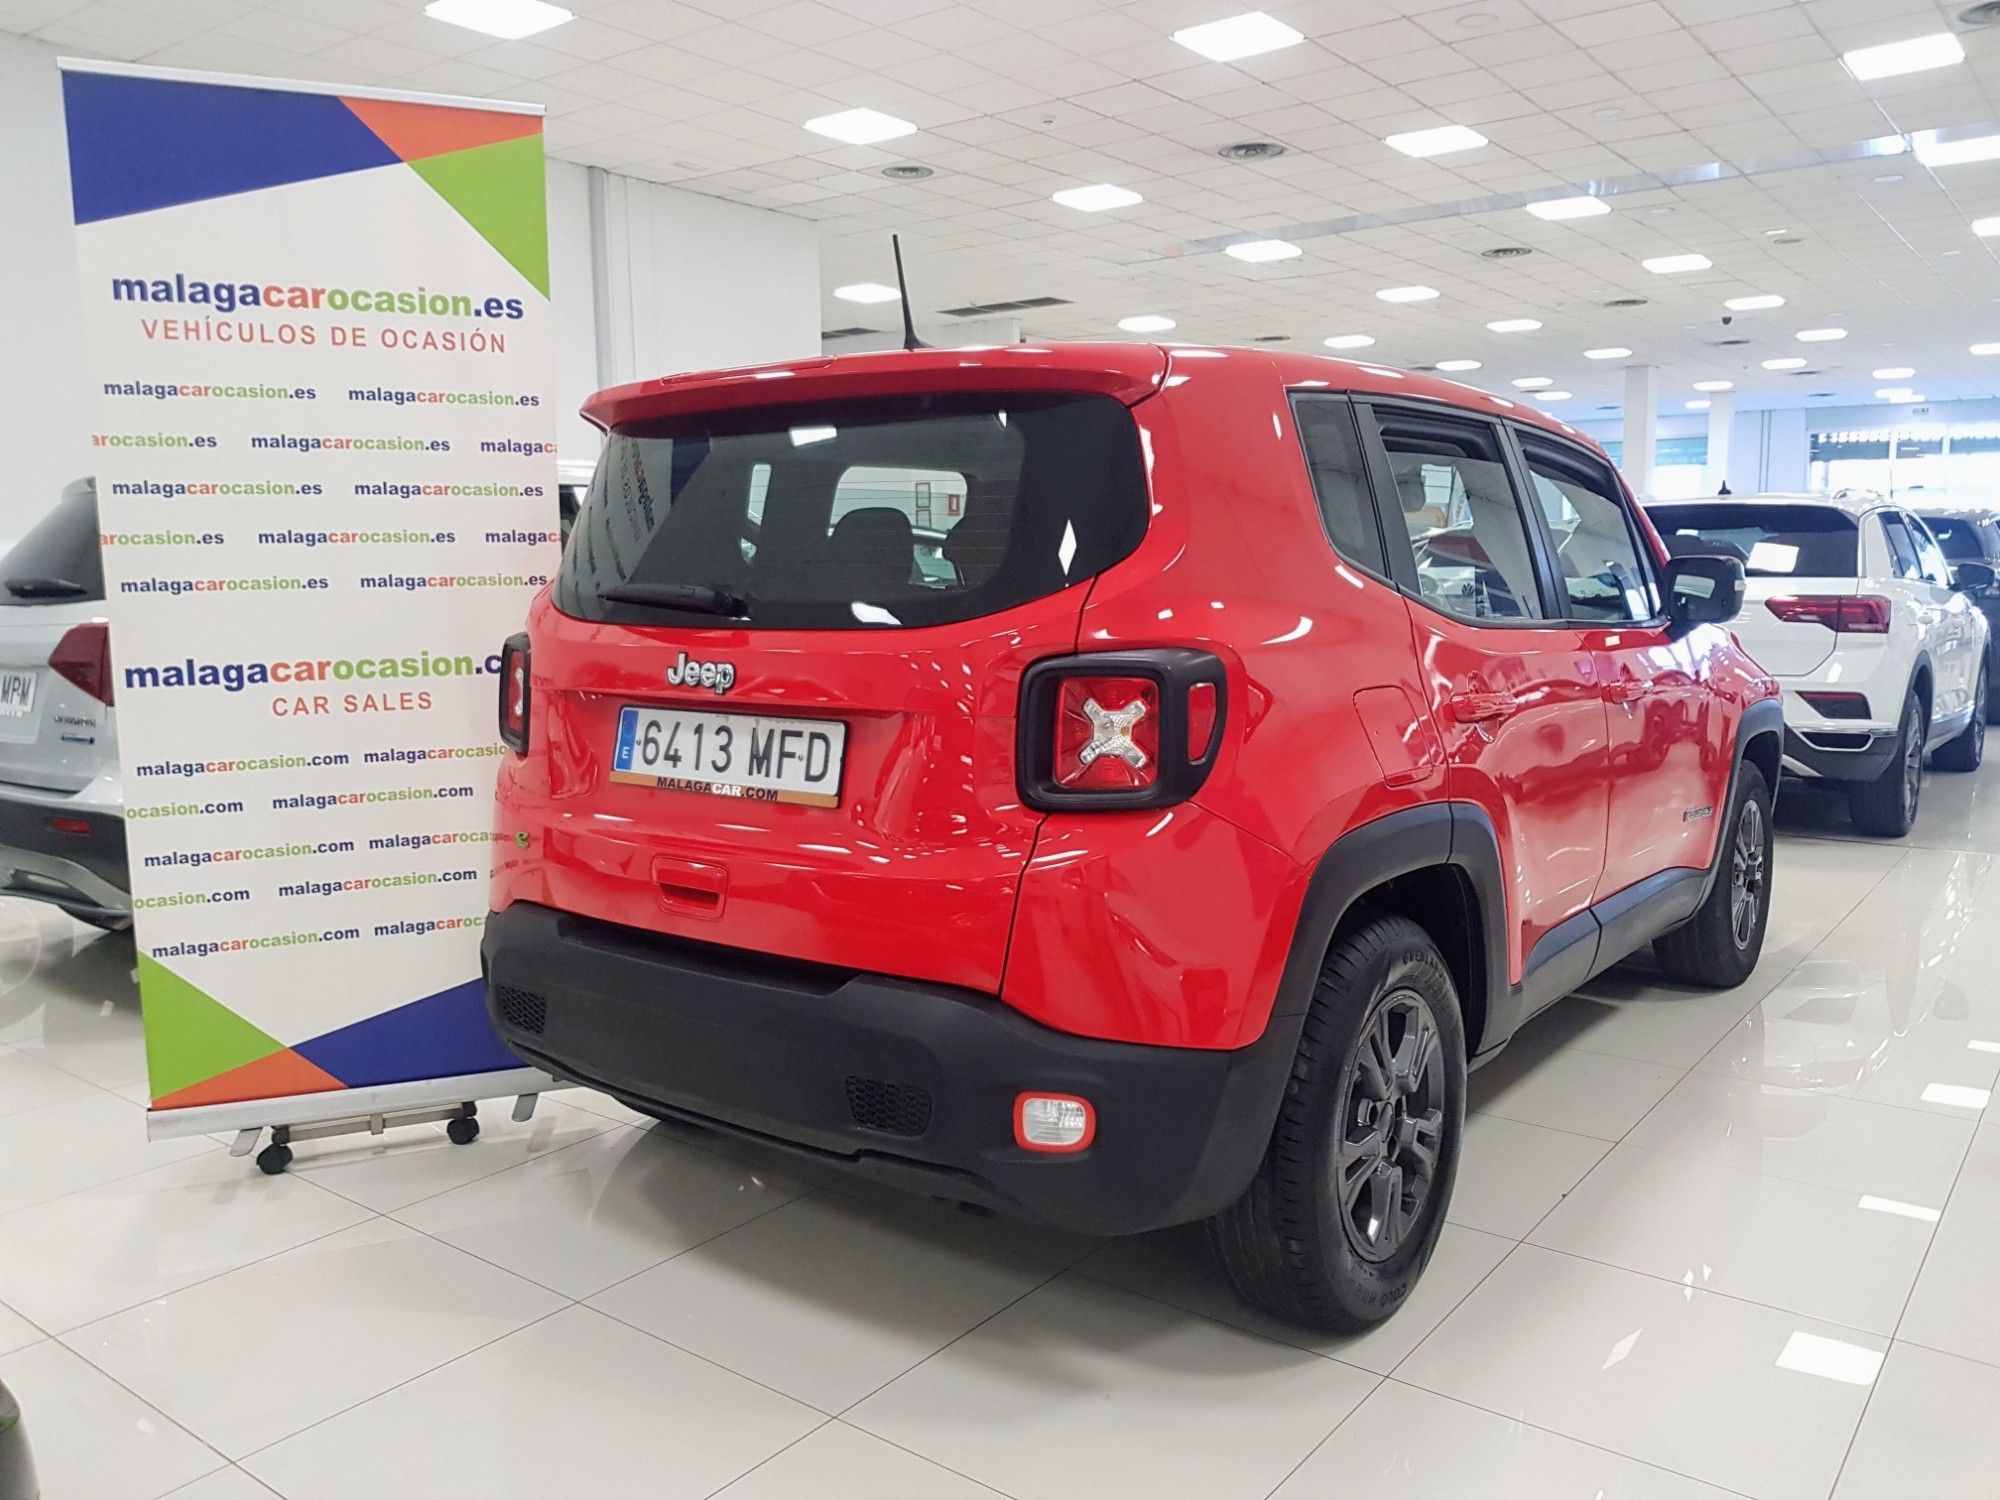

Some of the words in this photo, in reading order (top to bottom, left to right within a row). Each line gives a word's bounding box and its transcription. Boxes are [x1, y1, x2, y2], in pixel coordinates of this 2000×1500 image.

[112, 273, 524, 319] malagacarocasion.es
[141, 316, 315, 345] VEHÍCULOS
[331, 327, 366, 347] DE
[381, 328, 504, 353] OCASIÓN
[104, 380, 316, 401] malagacarocasion.es
[349, 387, 539, 407] malagacarocasion.es
[252, 433, 450, 452] malagacarocasion.es
[481, 438, 557, 456] malagac
[113, 480, 323, 499] malagacarocasion.es
[355, 481, 543, 500] malagacarocasion.es
[258, 530, 455, 548] malagacarocasion.es
[121, 576, 328, 595] malagacarocasion.es
[360, 573, 547, 590] malagacarocasion.es
[667, 652, 735, 694] Jeep
[273, 696, 330, 717] CAR
[344, 691, 432, 713] SALES
[622, 746, 630, 759] E
[642, 719, 734, 773] 6413
[748, 727, 831, 782] MFD
[136, 753, 349, 777] malagacarocasion.com
[272, 786, 473, 810] malagacarocasion.com
[656, 776, 779, 801] MALAGACAR.COM
[144, 840, 354, 868] malagacarocasion.com
[279, 870, 478, 897] malagacarocasion.com
[152, 928, 360, 958] malagacarocasion.com
